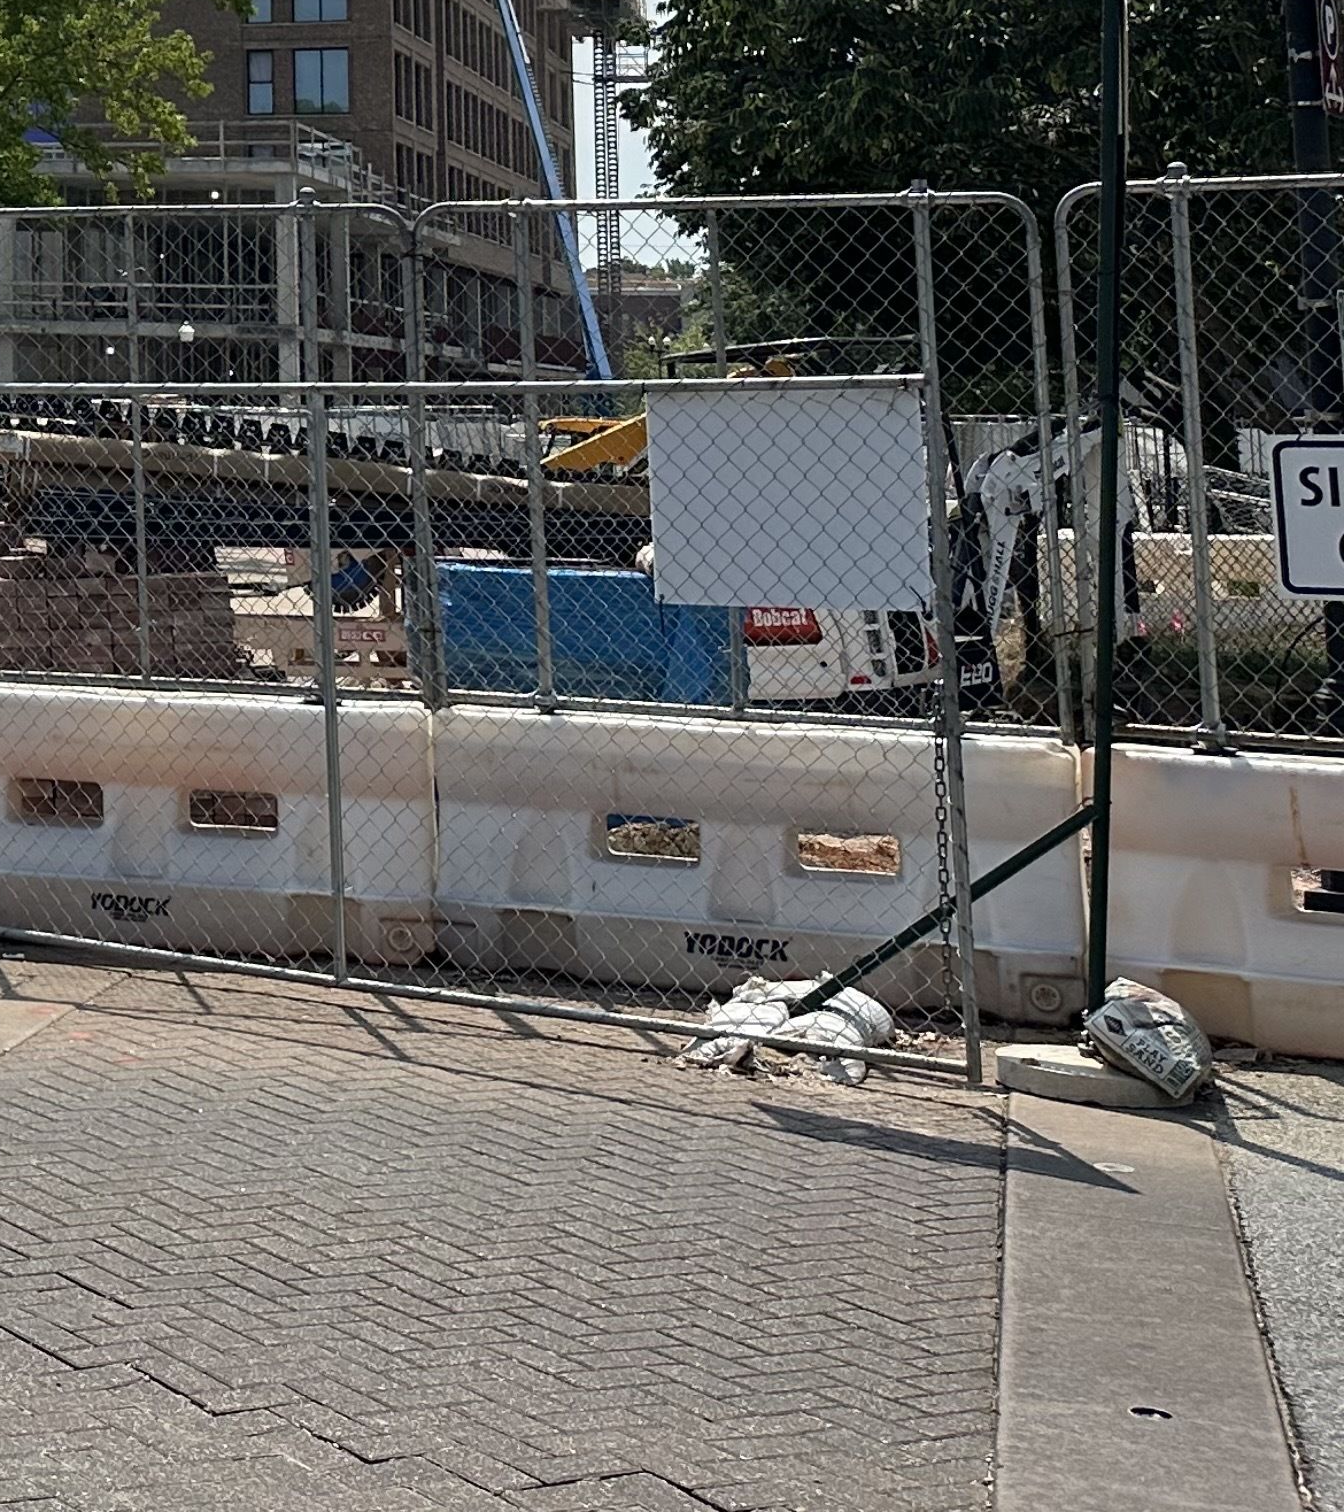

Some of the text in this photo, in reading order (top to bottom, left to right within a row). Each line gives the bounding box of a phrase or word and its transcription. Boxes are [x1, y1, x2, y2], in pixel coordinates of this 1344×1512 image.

[752, 608, 808, 627] Bobcat
[91, 892, 171, 917] YODOCK
[684, 931, 790, 962] YODOCK
[1128, 1043, 1164, 1075] SAND
[1136, 1038, 1168, 1064] PLAY
